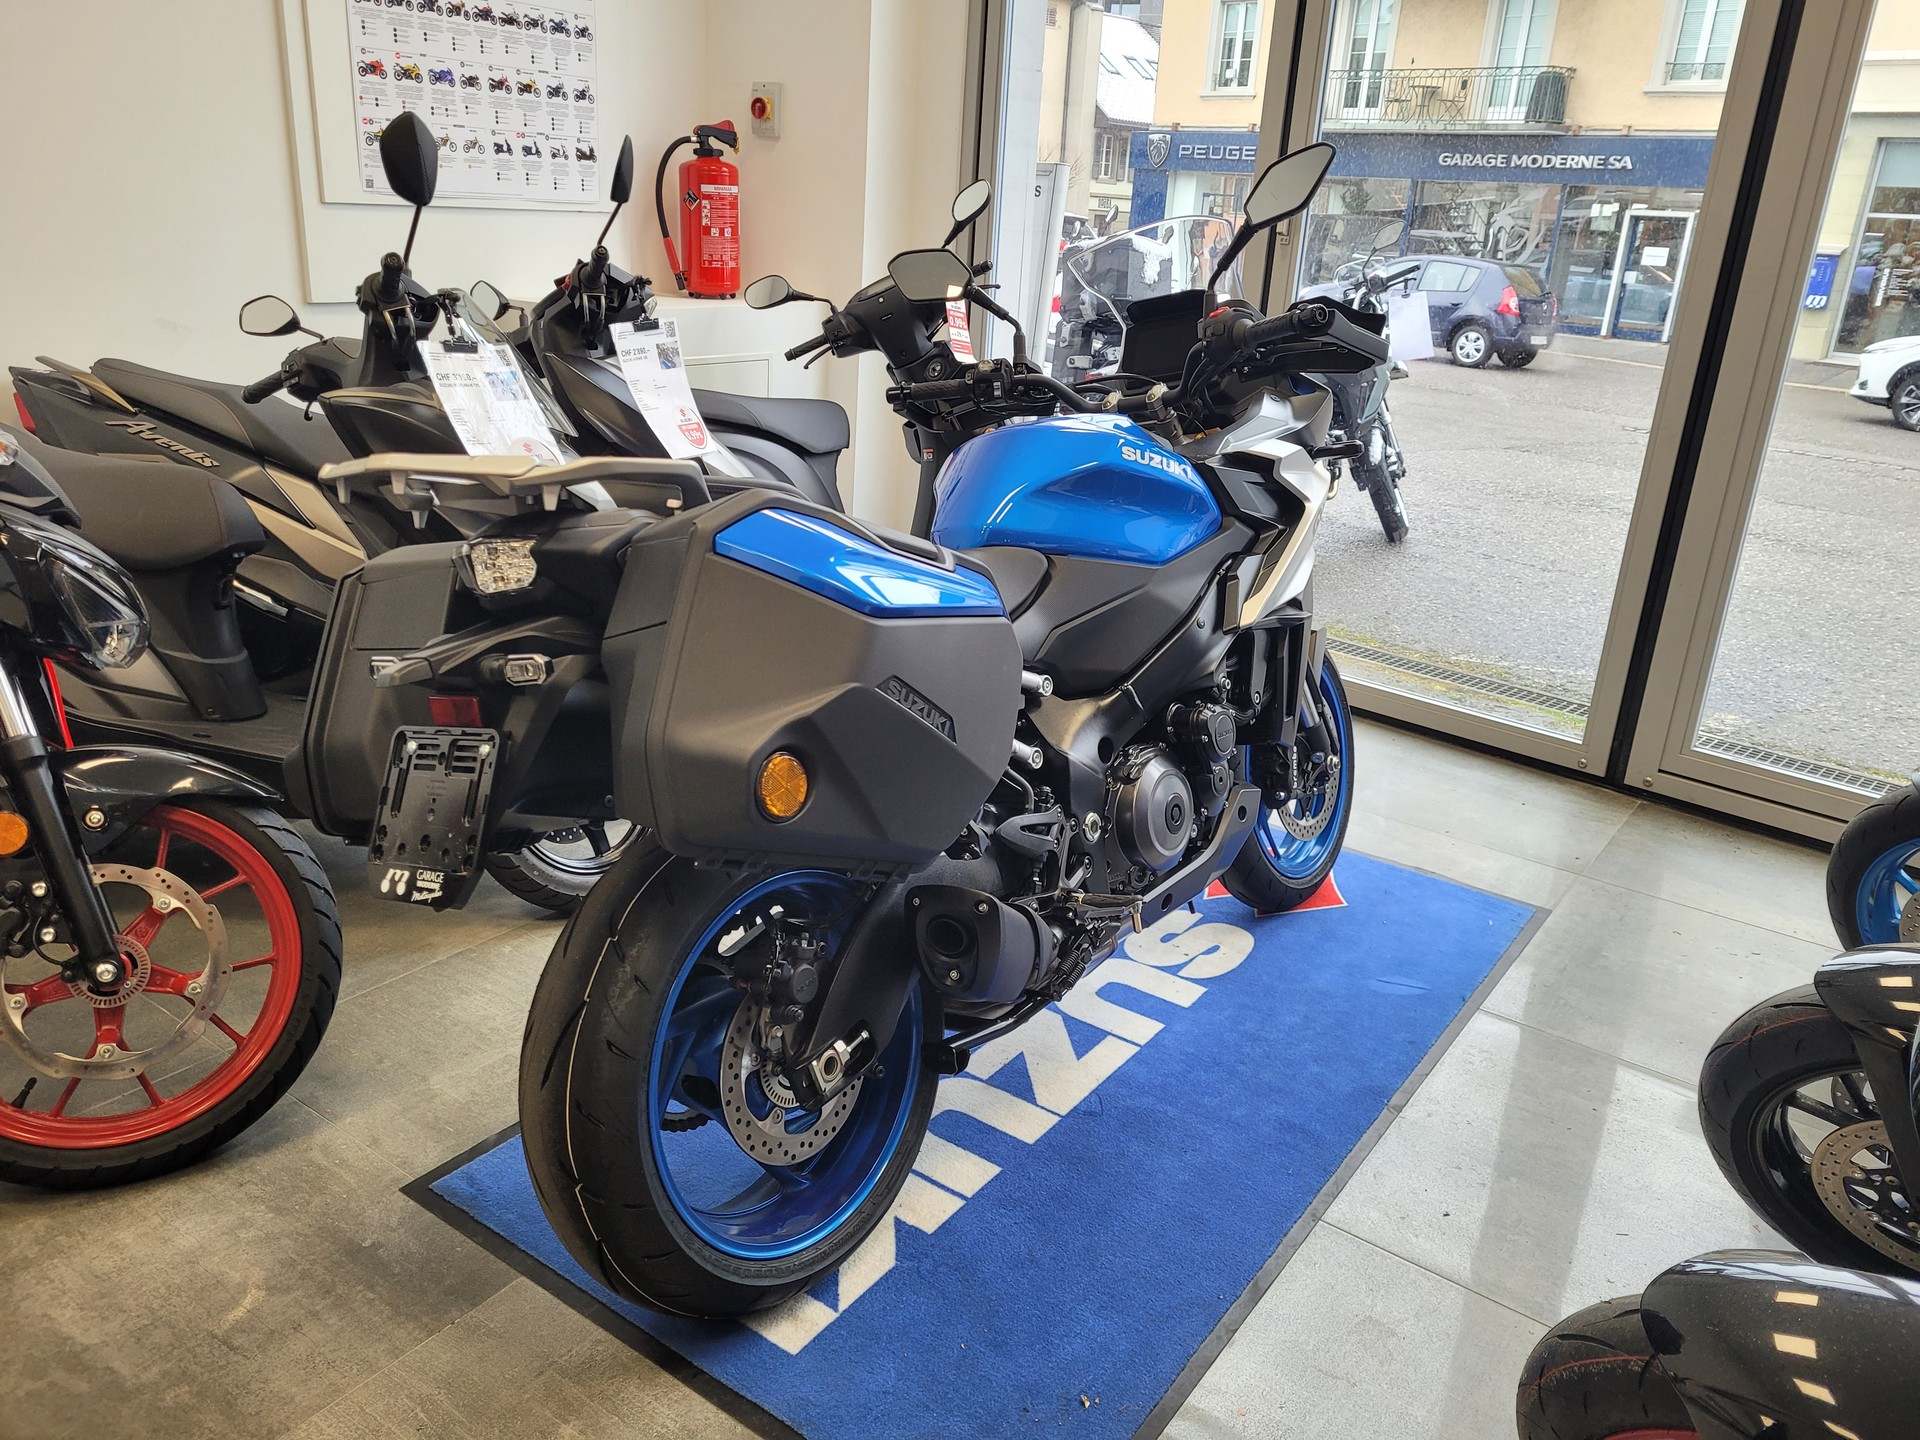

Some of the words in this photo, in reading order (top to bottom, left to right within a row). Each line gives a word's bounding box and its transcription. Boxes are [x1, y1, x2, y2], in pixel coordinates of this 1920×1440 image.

[1178, 144, 1257, 161] PEUGE
[1438, 152, 1508, 168] GARAGE
[1510, 154, 1606, 169] MODERNE
[1607, 155, 1634, 170] SA
[1034, 185, 1042, 198] S
[620, 348, 632, 358] CHF
[436, 372, 451, 382] CHF
[105, 420, 221, 468] Avenis
[1121, 445, 1192, 479] SUZUKI
[887, 679, 952, 737] SUZUKI
[416, 869, 445, 883] GARAGE
